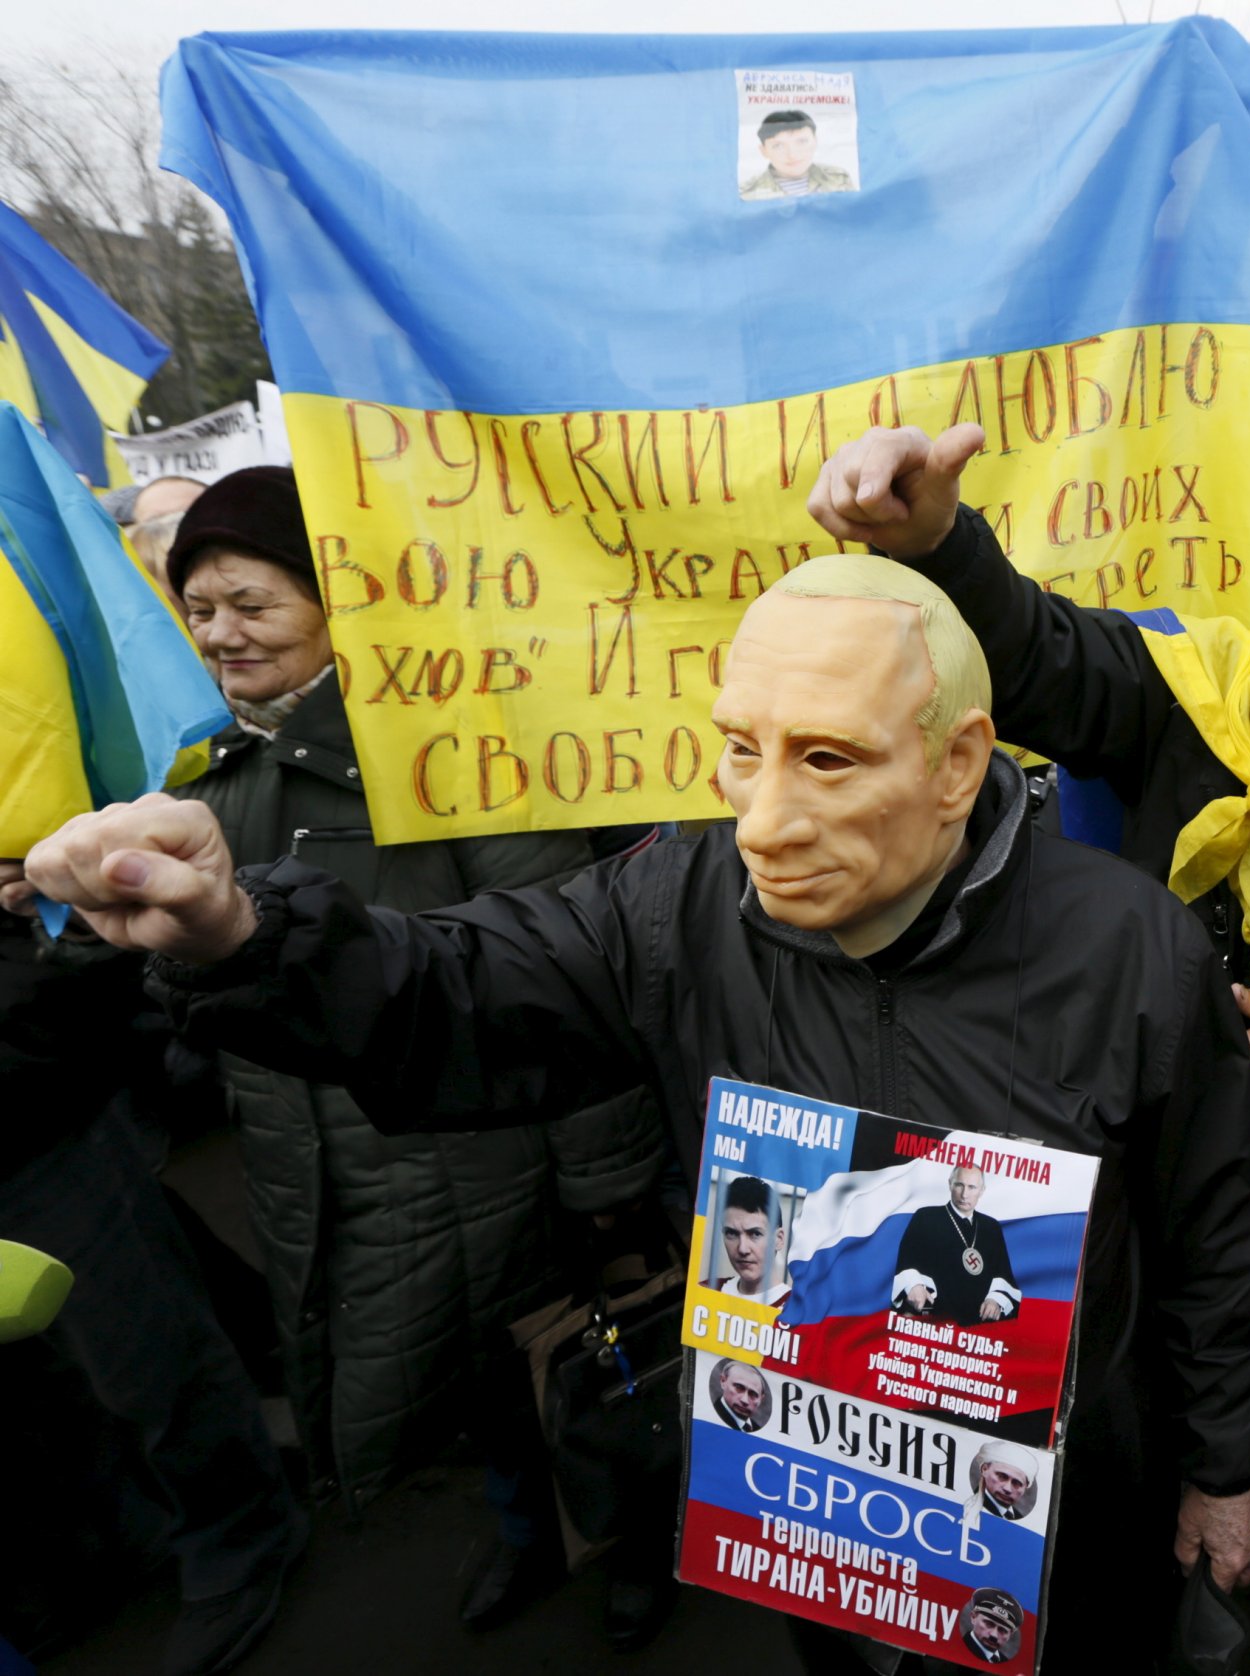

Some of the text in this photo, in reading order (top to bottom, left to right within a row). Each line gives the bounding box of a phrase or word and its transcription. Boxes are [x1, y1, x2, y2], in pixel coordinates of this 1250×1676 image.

[346, 398, 738, 515] РУССКИЙ
[776, 393, 831, 489] И
[949, 325, 1223, 456] ЛЮБЛЮ
[317, 535, 540, 618] ВОЮ
[582, 514, 846, 604] УКРАИ
[1046, 464, 1211, 549] СВОИХ
[585, 601, 641, 699] И
[411, 726, 727, 817] СВОБО
[714, 1135, 746, 1163] МЫ
[717, 1091, 844, 1151] НАДЕЖДА!
[894, 1131, 1052, 1186] ИМЕНЕМ ПУТИНА
[691, 1305, 801, 1366] С ТОБОЙ!
[887, 1311, 1009, 1357] Главный судья-
[867, 1352, 1017, 1405] убийца Украинского и
[877, 1374, 1002, 1423] Русского народов!
[779, 1381, 958, 1491] РОССИЯ
[744, 1452, 992, 1568] СБРОСЬ
[759, 1510, 918, 1586] террориста
[715, 1535, 960, 1642] ТИРАНА-УБИЙЦУ
